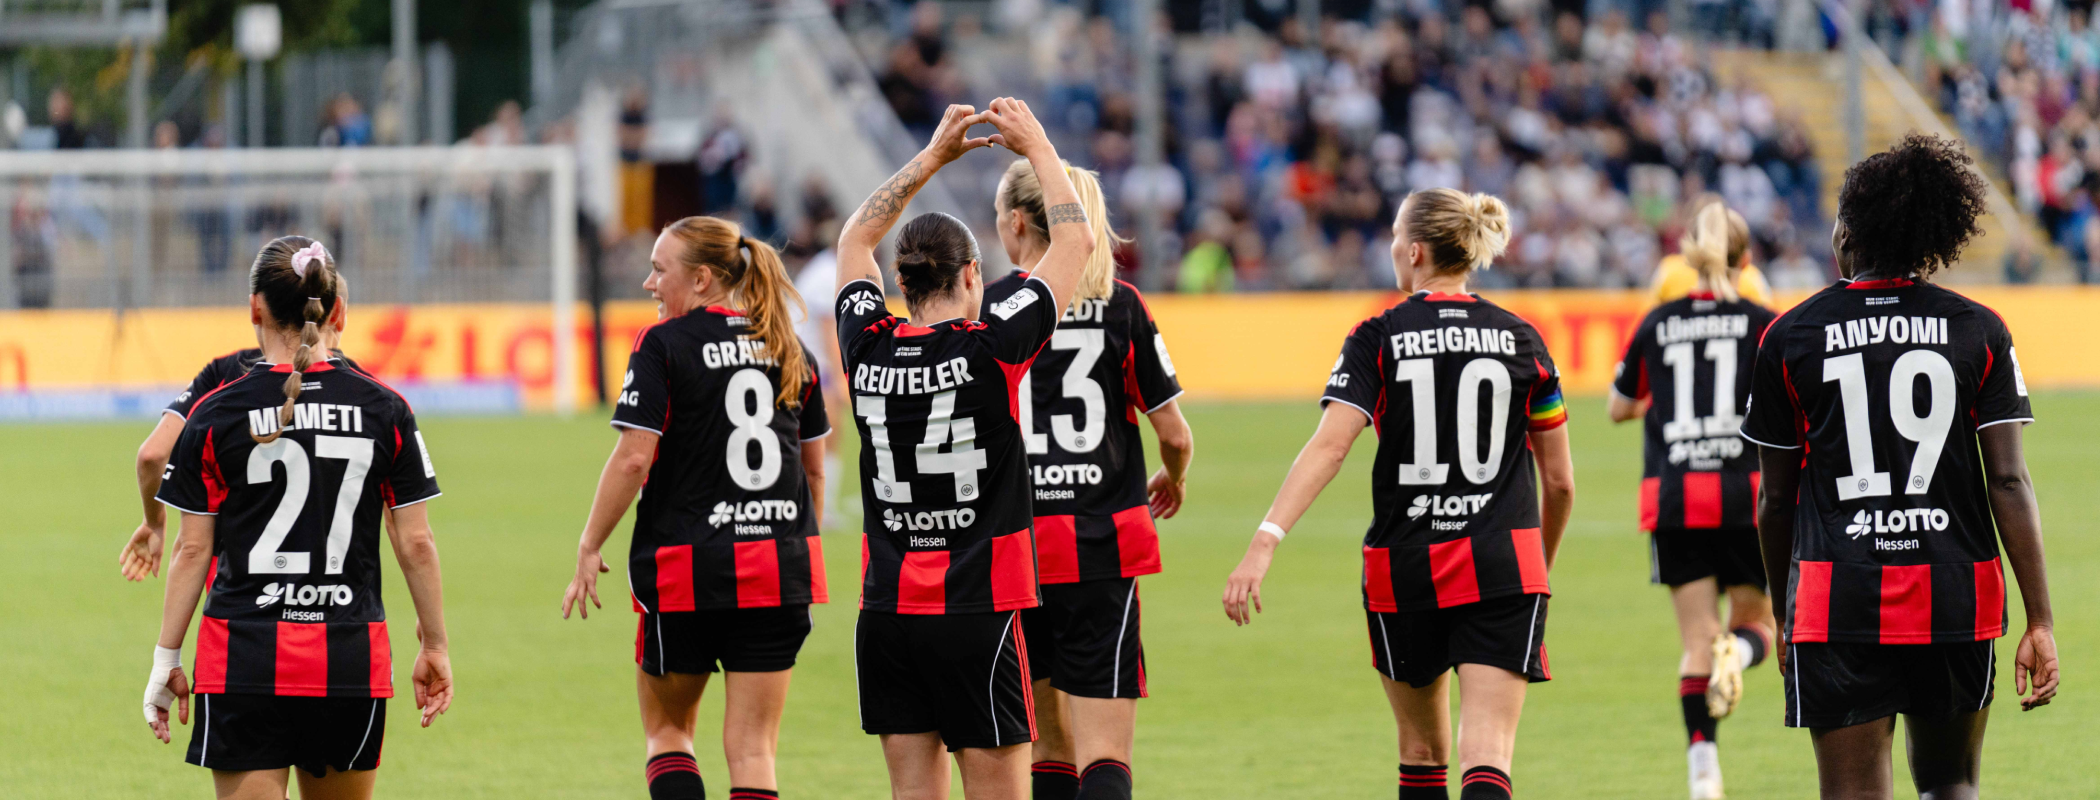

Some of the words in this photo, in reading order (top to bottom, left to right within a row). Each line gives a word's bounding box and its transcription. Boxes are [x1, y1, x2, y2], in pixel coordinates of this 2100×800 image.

[1391, 326, 1517, 360] FREIGANG
[1824, 315, 1949, 352] ANYOMI
[703, 334, 779, 369] GRÄ
[854, 356, 974, 395] REUTELER
[1326, 373, 1350, 388] AG
[617, 389, 640, 407] AG
[1018, 328, 1107, 454] 13
[1663, 338, 1744, 443] 11
[725, 368, 782, 491] 8
[1396, 357, 1512, 485] 10
[1822, 349, 1957, 501] 19
[856, 389, 987, 503] 14
[1034, 463, 1103, 485] LOTTO
[247, 434, 375, 575] 27
[1035, 489, 1075, 500] Hessen
[734, 499, 798, 522] LOTTO
[903, 507, 976, 531] LOTTO
[1874, 507, 1949, 533] LOTTO
[735, 524, 772, 536] Hessen
[909, 535, 946, 547] Hessen
[1875, 537, 1920, 551] Hessen
[284, 583, 353, 606] LOTTO
[282, 608, 324, 621] Hessen
